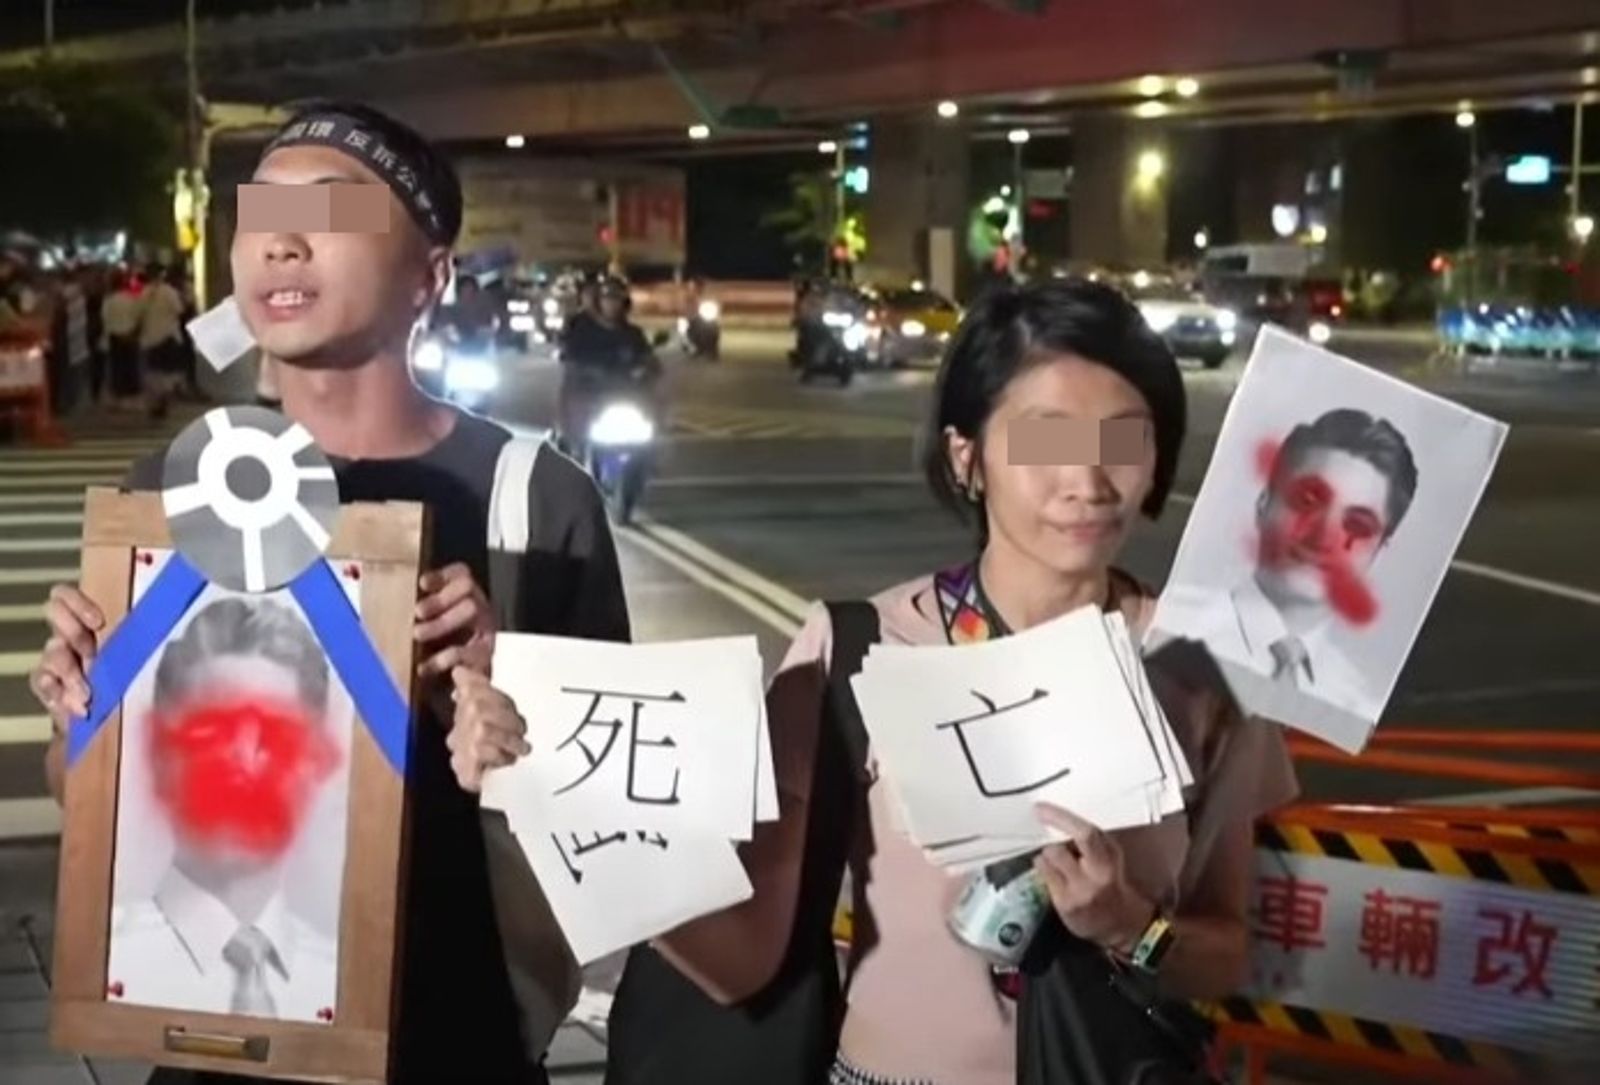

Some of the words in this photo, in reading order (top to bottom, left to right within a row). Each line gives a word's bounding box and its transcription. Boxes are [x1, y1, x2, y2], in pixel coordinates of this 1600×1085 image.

[552, 685, 687, 806] 死
[935, 688, 1071, 799] 亡
[1253, 874, 1559, 1001] 車輛改
